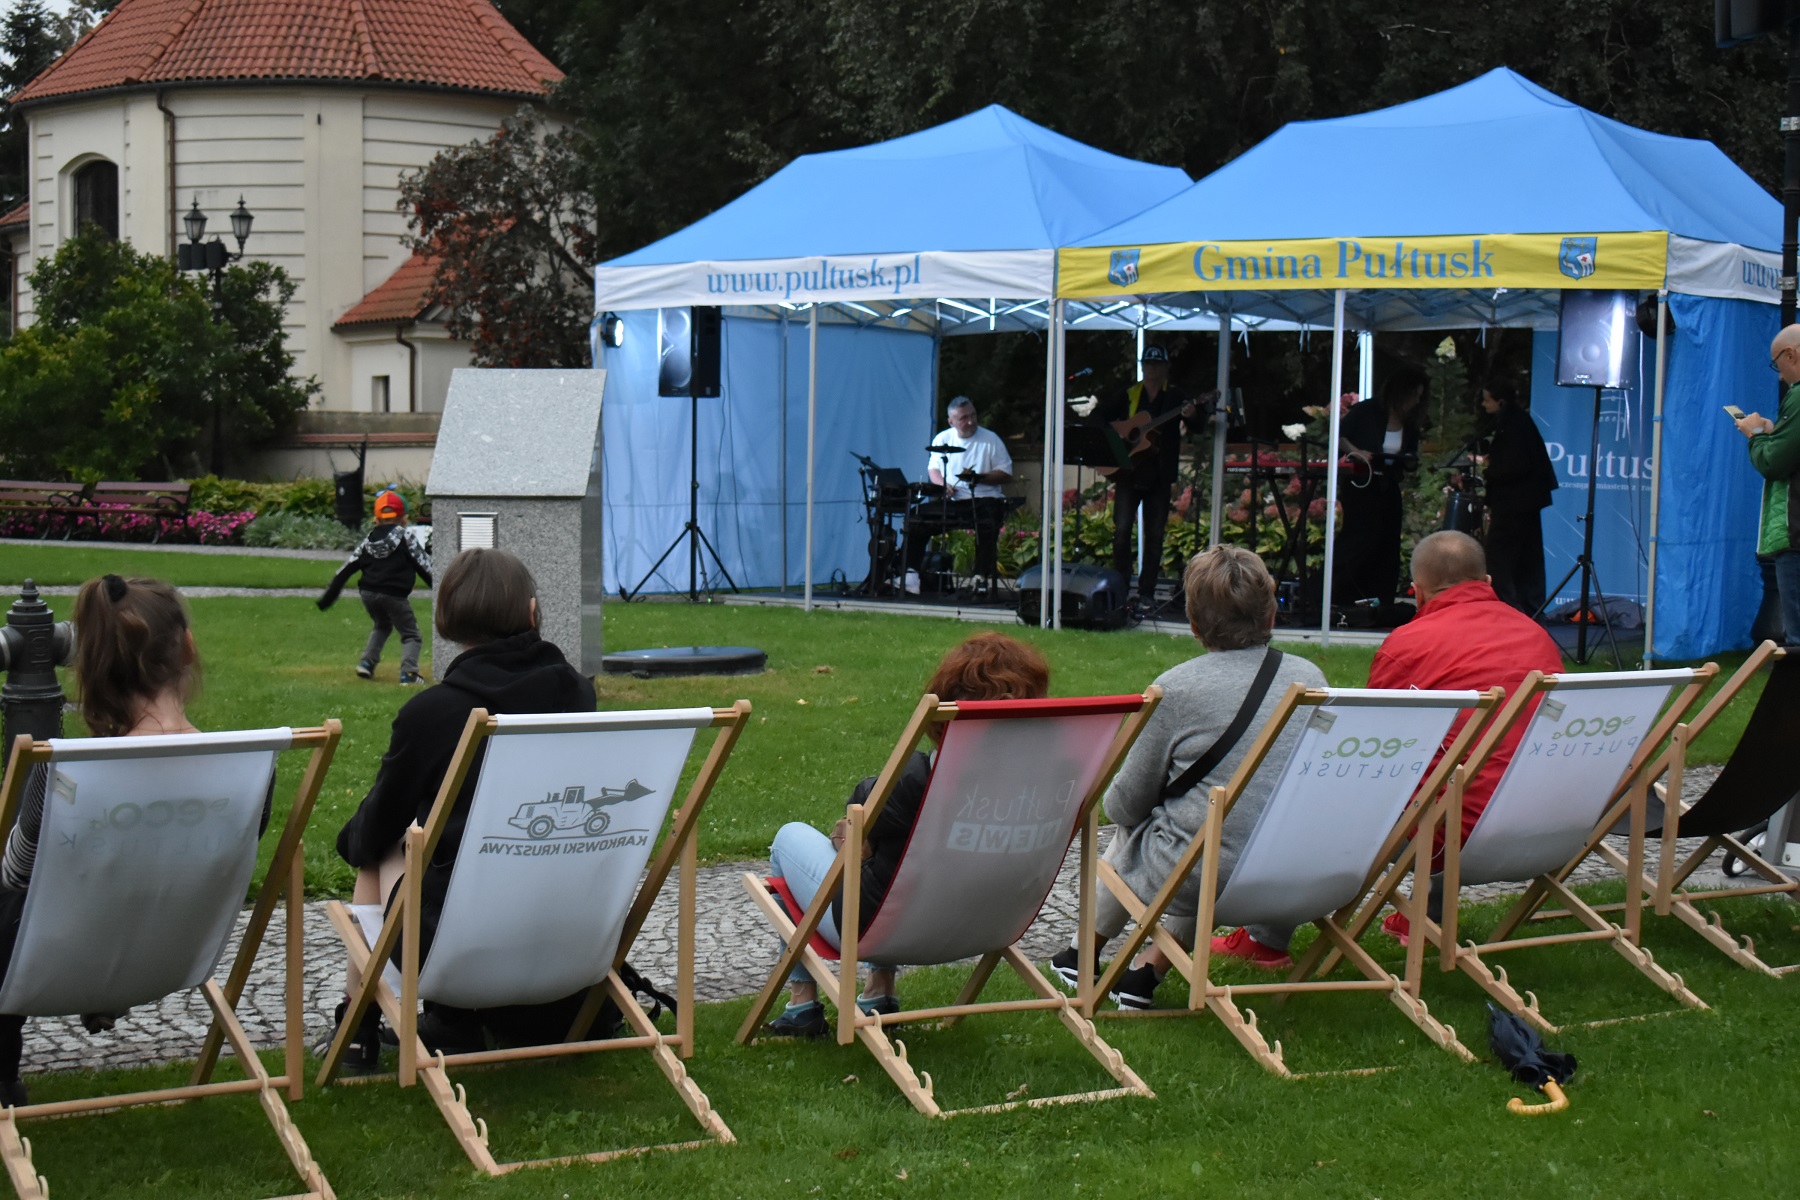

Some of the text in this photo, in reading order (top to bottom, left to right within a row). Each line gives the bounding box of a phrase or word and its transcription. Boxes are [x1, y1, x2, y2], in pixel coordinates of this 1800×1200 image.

[706, 255, 920, 299] www.pultusk.pl
[1193, 239, 1495, 282] Gmina Pułtusk
[1544, 442, 1652, 479] Pułtus
